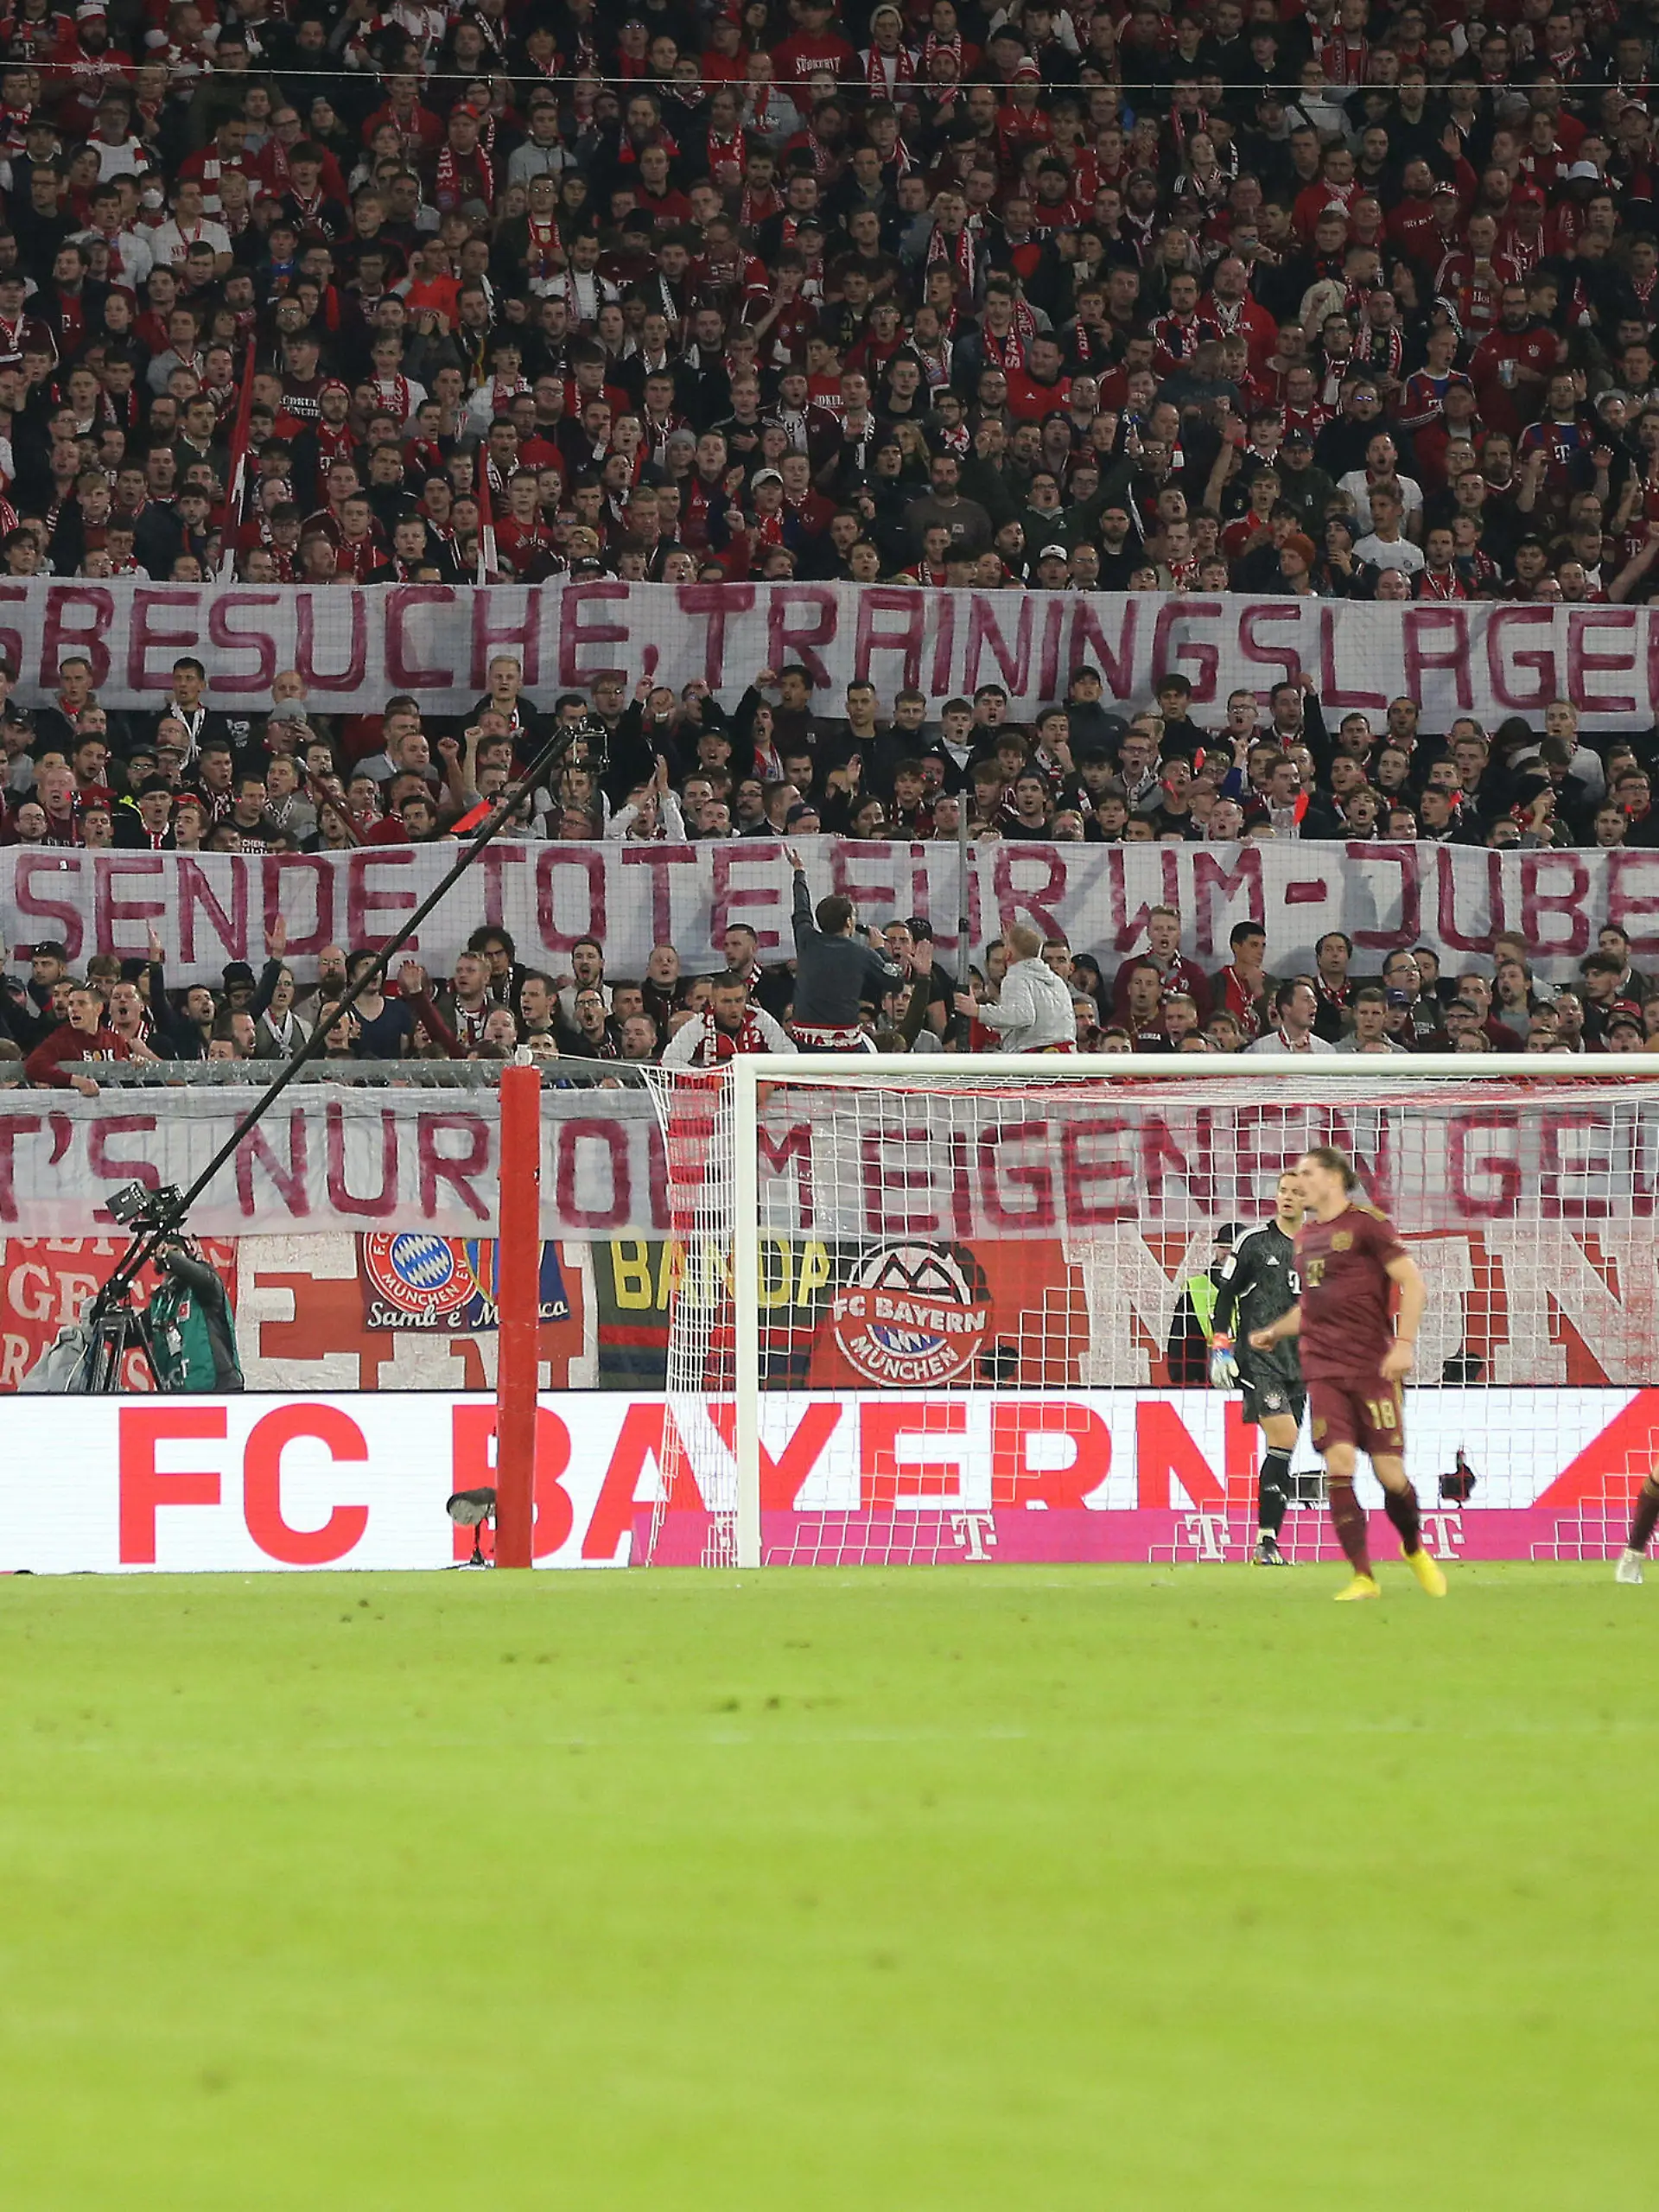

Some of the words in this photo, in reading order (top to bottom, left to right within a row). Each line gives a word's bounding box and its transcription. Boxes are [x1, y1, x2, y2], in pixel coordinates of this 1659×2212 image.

[676, 583, 1659, 711] TRAININGSLAGE
[14, 850, 419, 963] SENDE
[459, 844, 781, 950] TOTE
[235, 1102, 490, 1220] NUR
[861, 1106, 1393, 1237] EIGENEN
[834, 1295, 866, 1321] FC
[874, 1296, 986, 1333] BAYERN
[1365, 1398, 1396, 1430] 18
[119, 1402, 369, 1566] FC
[452, 1401, 1259, 1565] BAYERN
